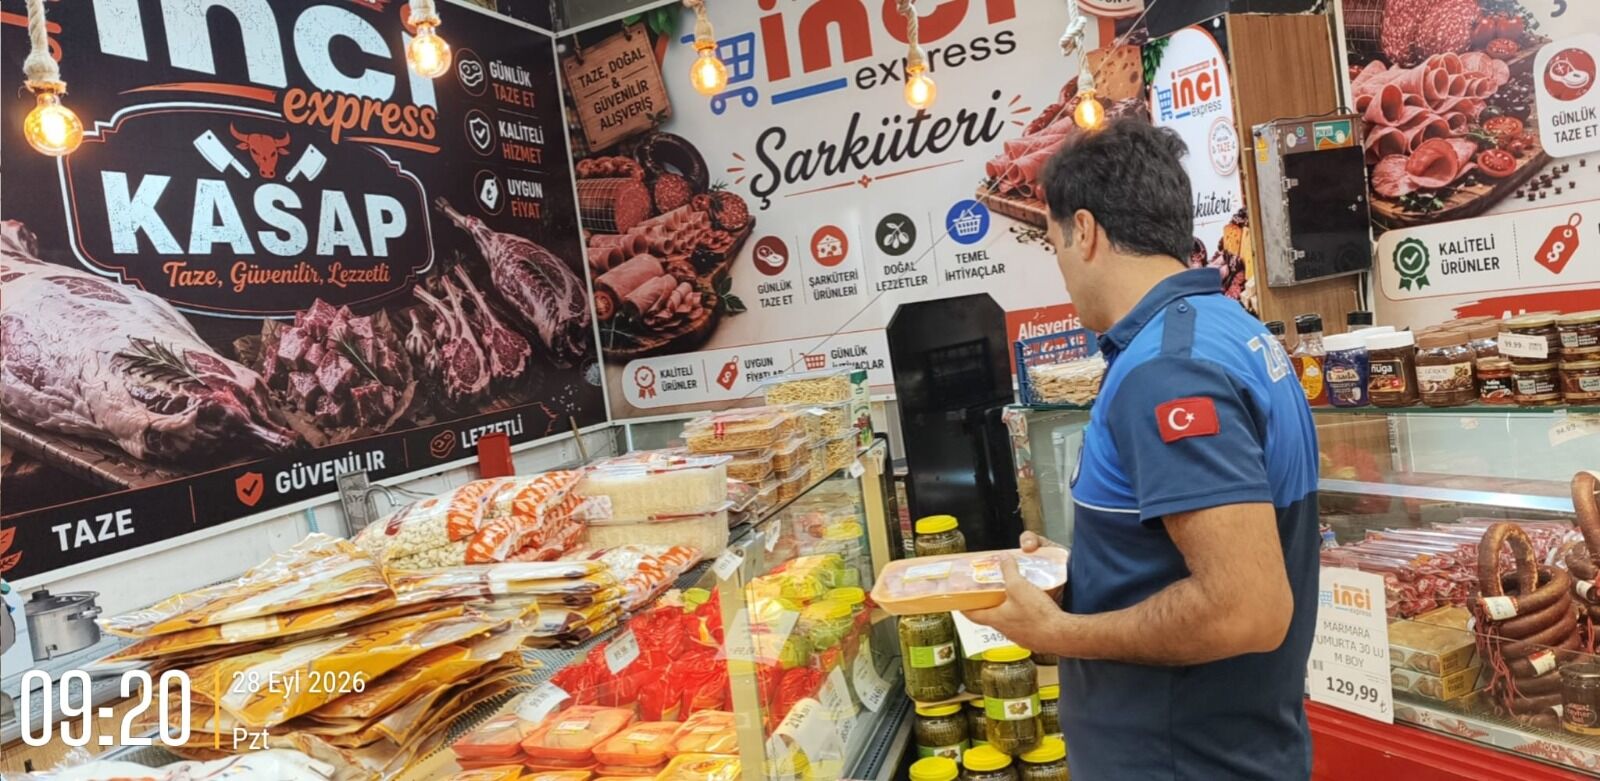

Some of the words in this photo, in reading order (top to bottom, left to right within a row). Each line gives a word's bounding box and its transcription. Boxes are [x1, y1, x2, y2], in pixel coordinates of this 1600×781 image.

[488, 59, 532, 88] GÜNLÜK
[577, 66, 609, 89] TAZE,
[608, 47, 646, 73] DOĞAL
[611, 77, 621, 89] &
[1171, 57, 1222, 110] inci
[491, 83, 520, 105] TAZE
[523, 90, 536, 108] ET
[593, 79, 649, 115] GÜVENİLİR
[283, 87, 437, 144] express
[600, 95, 654, 131] ALIŞVERİŞ
[1192, 99, 1223, 118] express
[1552, 107, 1597, 127] GÜNLÜK
[498, 119, 545, 146] KALİTELİ
[1554, 127, 1582, 144] TAZE
[1585, 124, 1598, 138] ET
[502, 142, 543, 164] HİZMET
[749, 89, 1005, 210] Şarküteri
[507, 178, 543, 199] UYGUN
[101, 170, 407, 257] KASAP
[511, 200, 541, 219] FİYAT
[1439, 233, 1496, 256] KALİTELİ
[955, 250, 990, 264] TEMEL
[1441, 256, 1500, 276] ÜRÜNLER
[163, 261, 223, 288] Taze,
[229, 261, 324, 293] Güvenilir,
[326, 263, 391, 288] Lezzetli
[808, 268, 859, 288] ŞARKÜTERİ
[883, 260, 917, 276] DOĞAL
[944, 263, 1006, 283] İHTİYAÇLAR
[757, 279, 793, 295] GÜNLÜK
[813, 283, 858, 301] ÜRÜNLERİ
[875, 274, 928, 293] LEZZETLER
[759, 296, 782, 309] TAZE
[782, 294, 793, 306] ET
[831, 344, 868, 359] GÜNLÜK
[659, 364, 694, 379] KALİTELİ
[744, 356, 774, 369] UYGUN
[661, 378, 697, 393] ÜRÜNLER
[51, 508, 136, 552] TAZE
[1333, 583, 1372, 611] inci
[1323, 620, 1370, 639] MARMARA
[1316, 634, 1357, 651] UMURTA
[1359, 642, 1371, 655] 30
[1334, 652, 1343, 664] M
[1345, 654, 1365, 668] BOY
[1325, 676, 1379, 703] 129,99
